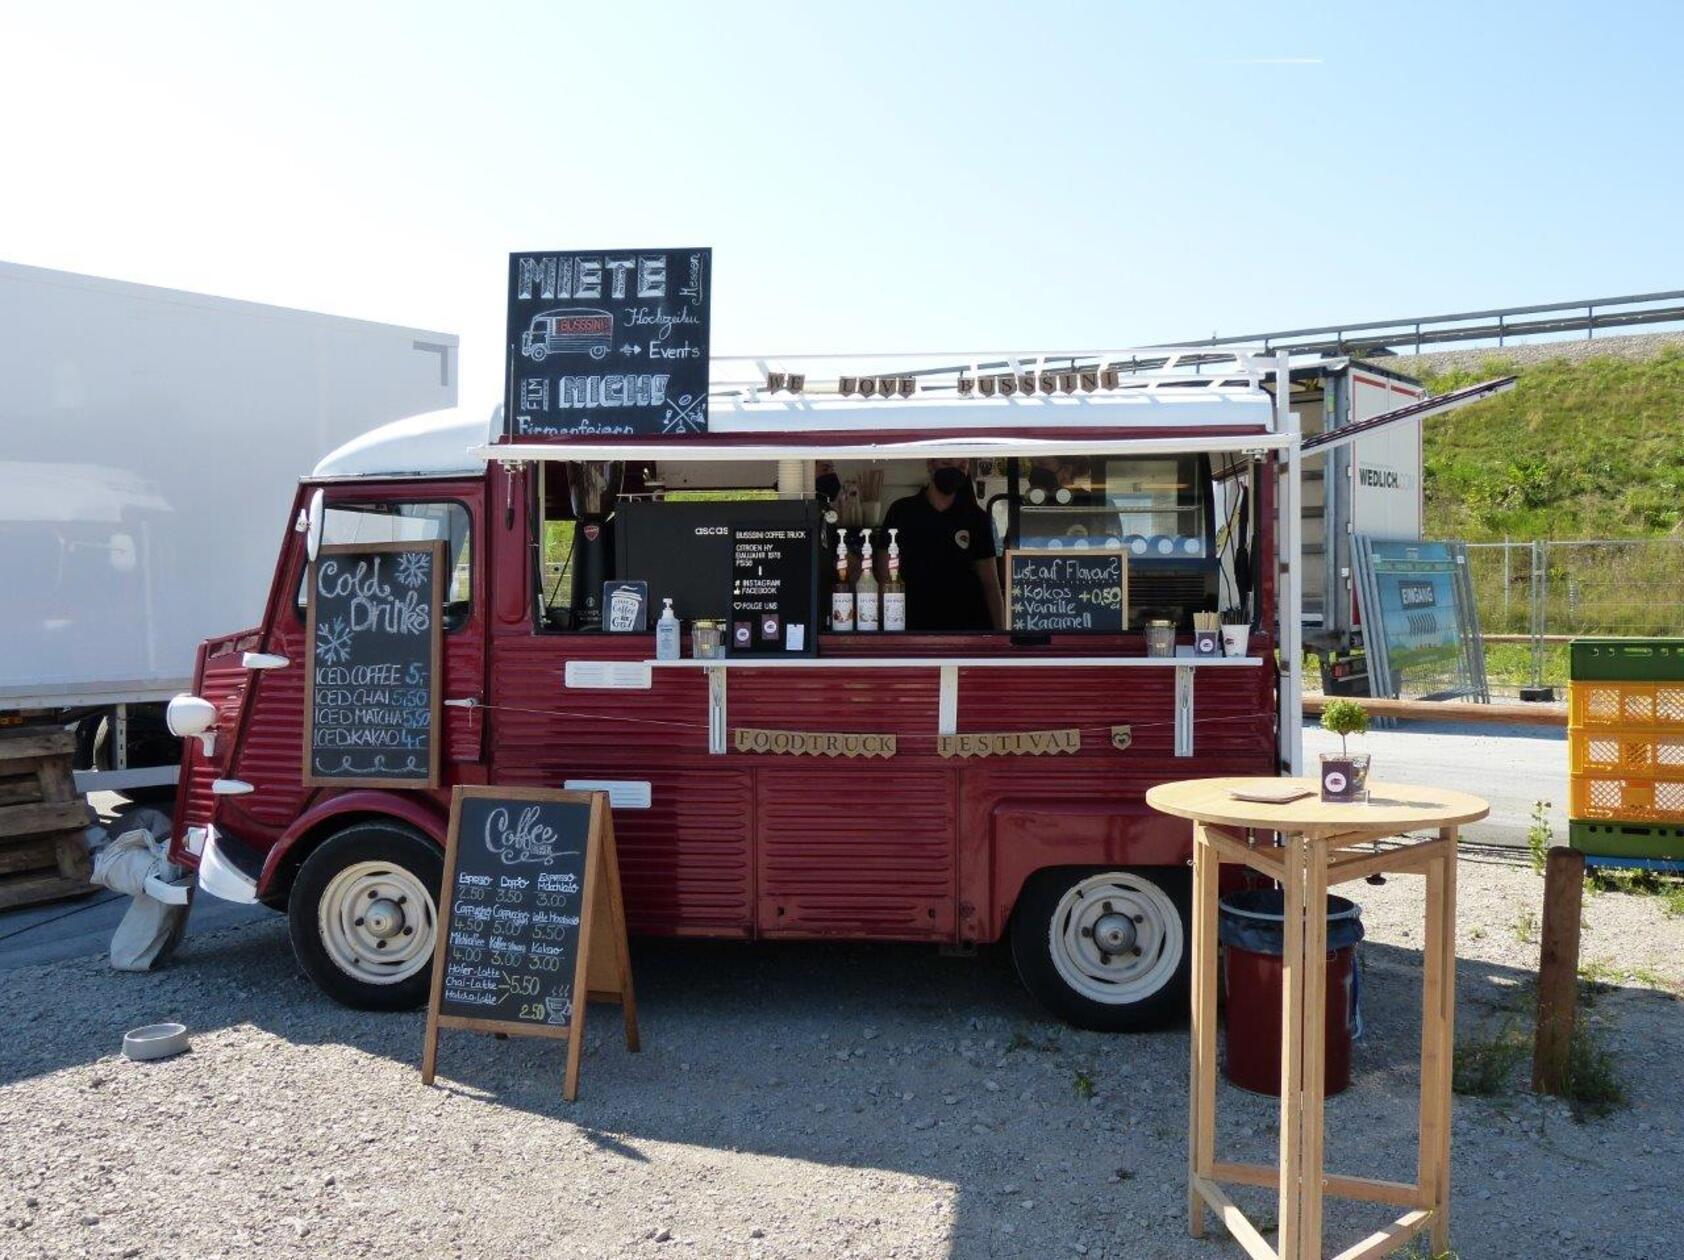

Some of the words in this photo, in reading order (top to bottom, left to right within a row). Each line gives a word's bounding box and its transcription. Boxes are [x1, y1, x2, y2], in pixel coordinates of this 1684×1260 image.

[518, 255, 667, 299] MIETE
[649, 340, 700, 359] Events
[527, 377, 543, 411] FILM
[767, 373, 804, 392] WE
[841, 377, 914, 394] LOVE
[764, 530, 786, 539] COFFEE
[787, 530, 806, 539] TRUCK
[317, 556, 391, 599] Cold
[1038, 558, 1062, 580] auf
[1023, 584, 1072, 600] Kokos
[350, 590, 430, 636] Drinks
[1025, 600, 1076, 615] Vanille
[1026, 611, 1092, 630] Karamell
[316, 666, 350, 686] ICED
[350, 663, 401, 686] COFFEE
[315, 688, 352, 706] ICED
[353, 688, 389, 706] CHAI
[315, 707, 352, 725] ICED
[354, 707, 402, 726] MATCHA
[314, 728, 351, 747] ICED
[351, 728, 400, 747] KAKAO
[737, 730, 895, 752] FOODTRUCK
[942, 731, 1077, 753] FESTIVAL
[485, 806, 558, 853] Coffee
[510, 975, 541, 996] 5.50
